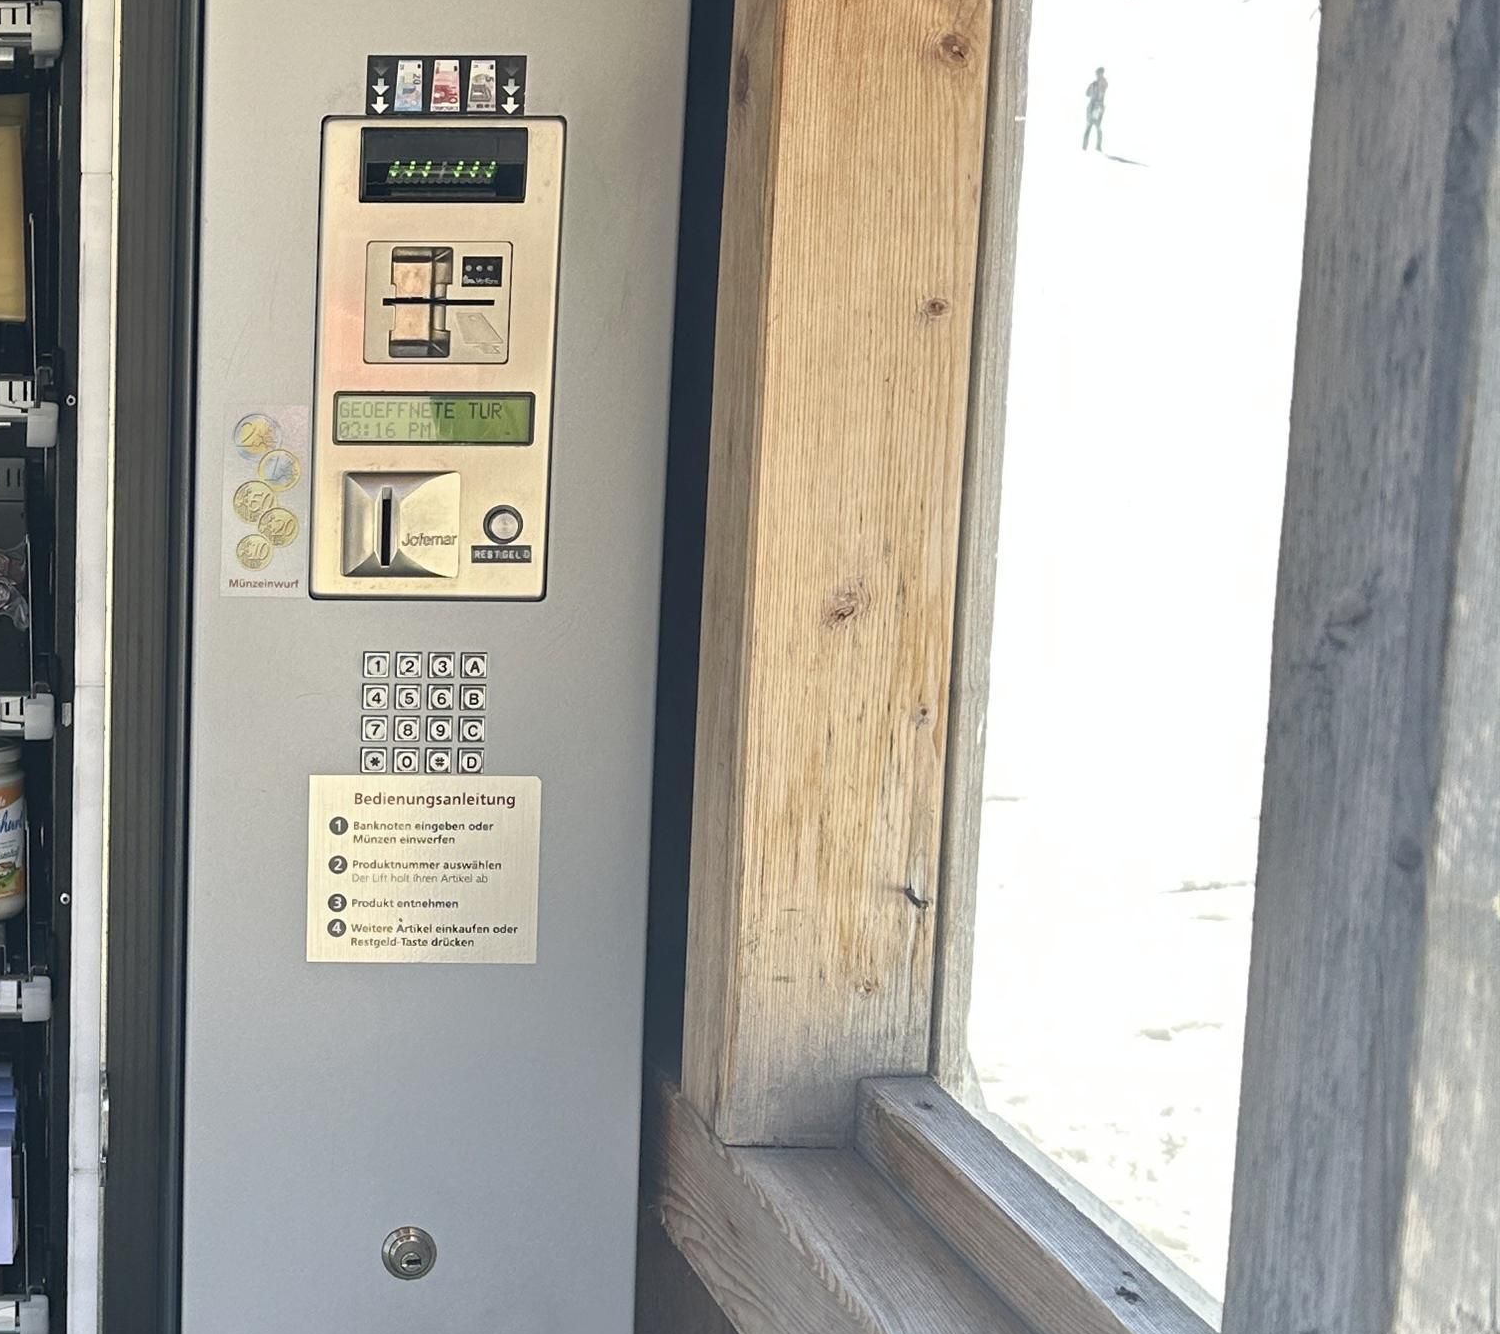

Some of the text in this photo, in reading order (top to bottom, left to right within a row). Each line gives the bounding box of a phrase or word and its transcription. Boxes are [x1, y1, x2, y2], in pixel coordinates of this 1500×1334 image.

[339, 402, 455, 419] GEOEFFNETE
[339, 422, 432, 439] 03:16 PM
[229, 579, 299, 589] Münzeinwurf
[354, 793, 516, 808] Bedienungsanleitung
[353, 822, 493, 833] Banknoten eingeben oder
[353, 834, 455, 844] Münzen einwerfen
[352, 860, 502, 870] Produktnummer auswählen
[351, 899, 458, 908] Produkt entnehmen
[351, 924, 518, 934] Weitere Artikel einkaufen oder
[350, 937, 474, 949] Restgeld-Taste drücken
